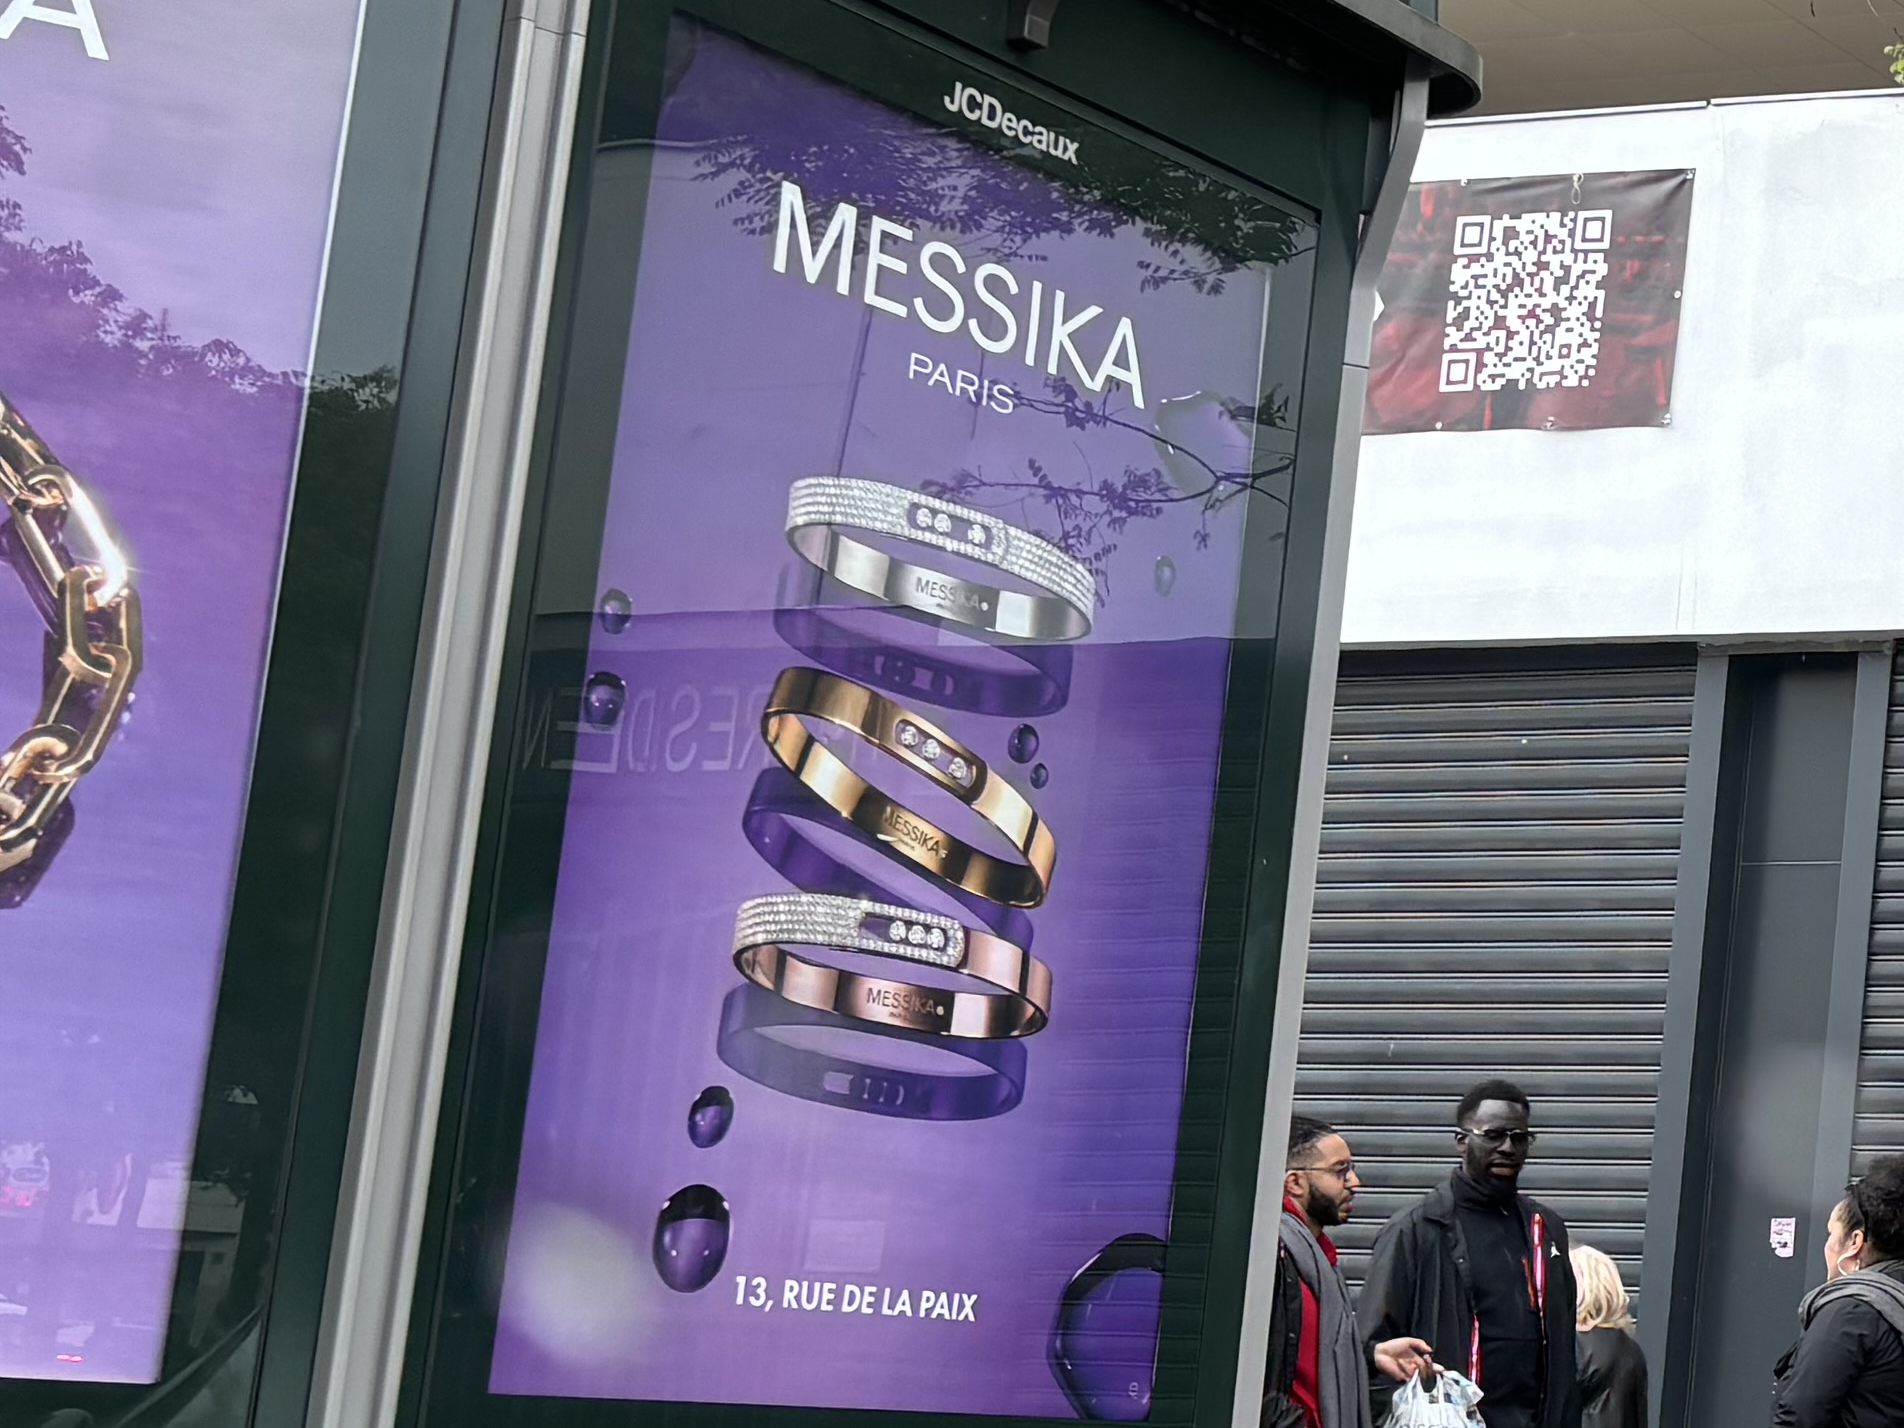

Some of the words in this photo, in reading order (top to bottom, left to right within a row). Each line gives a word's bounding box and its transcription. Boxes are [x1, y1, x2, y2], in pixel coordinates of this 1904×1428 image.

[943, 81, 1079, 165] JCDecaux
[773, 180, 1145, 409] MESSIKA
[909, 352, 1014, 414] PARIS
[735, 1275, 774, 1312] 13,
[782, 1279, 837, 1312] RUE
[841, 1284, 877, 1314] DE
[881, 1287, 913, 1317] LA
[919, 1290, 978, 1322] PAIX
